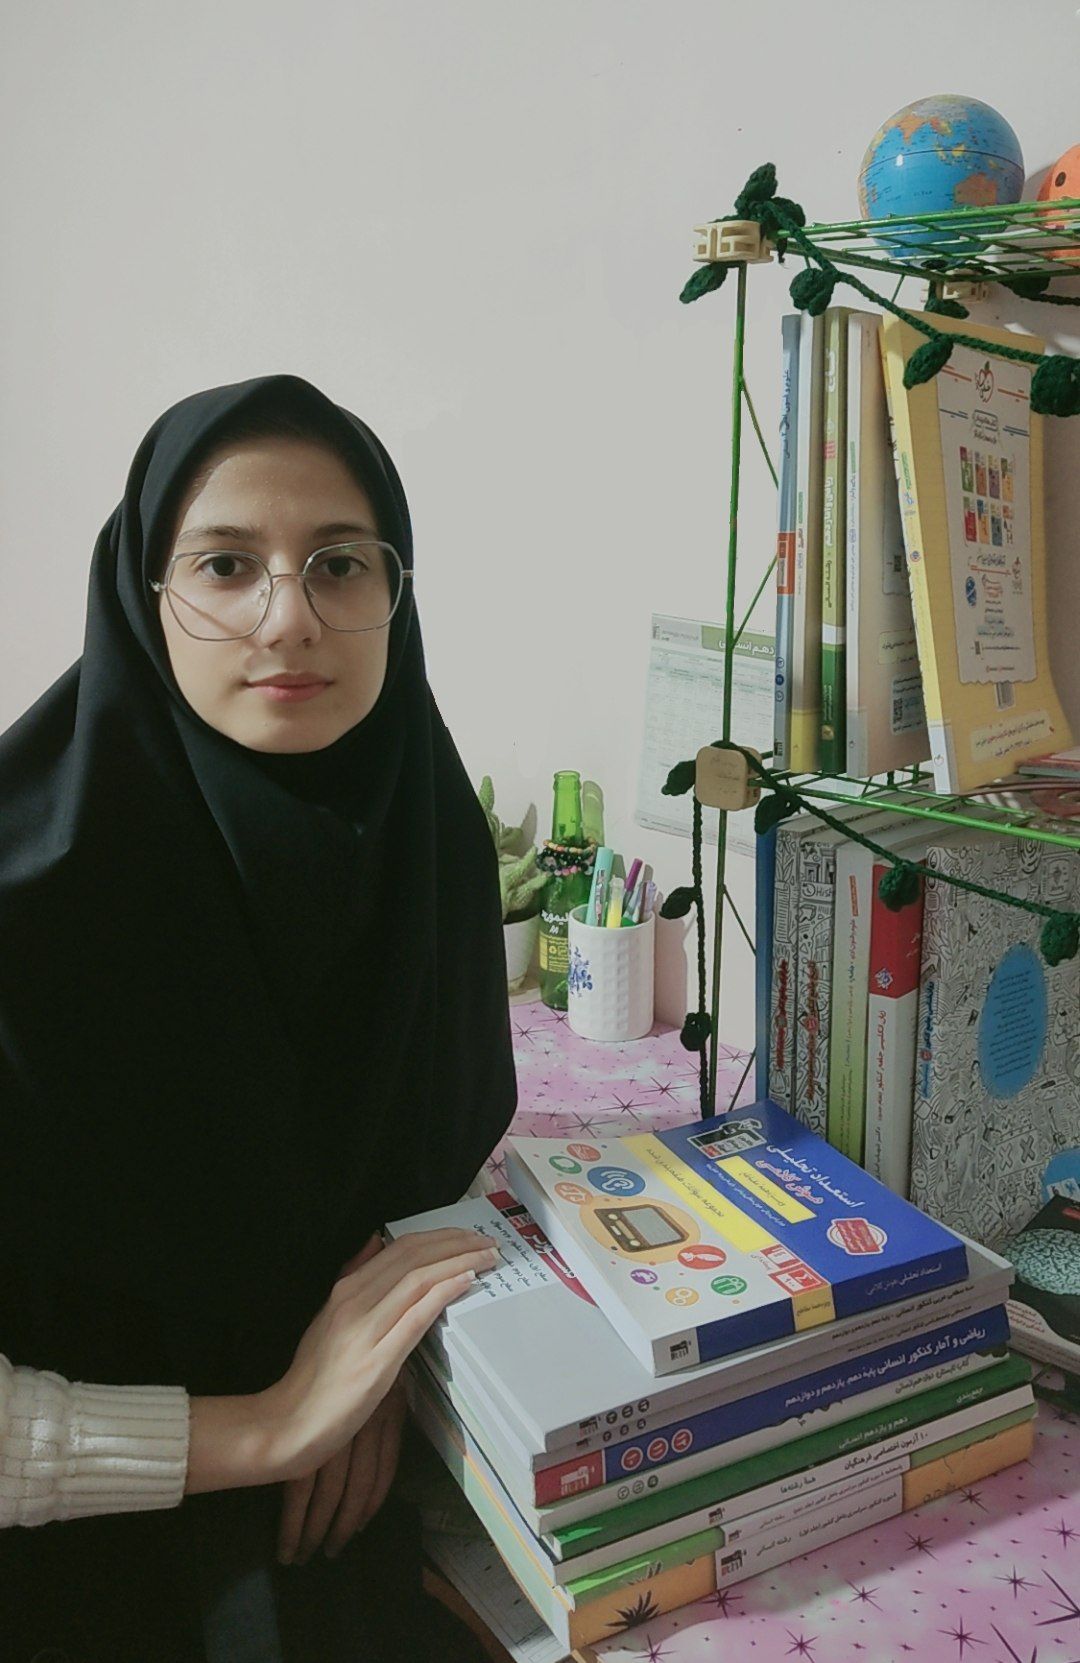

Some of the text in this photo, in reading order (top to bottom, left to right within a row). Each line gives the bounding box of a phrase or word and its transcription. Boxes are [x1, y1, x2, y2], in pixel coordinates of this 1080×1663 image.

[767, 1146, 815, 1176] تحلیلی
[785, 1176, 826, 1206] هوش
[812, 1170, 863, 1207] استعداد
[920, 1264, 941, 1276] استعداد
[915, 1298, 933, 1310] کنکور
[934, 1335, 950, 1355] آمار
[959, 1328, 985, 1345] ریاضی
[908, 1344, 932, 1363] کنکور
[877, 1355, 905, 1374] انسانی
[821, 1379, 844, 1394] یازدهم
[785, 1391, 815, 1406] دوازدهم
[893, 1417, 908, 1426] دهم
[901, 1433, 918, 1448] آزمون
[873, 1442, 899, 1460] اختصاصی
[845, 1454, 872, 1470] فرهنگیان
